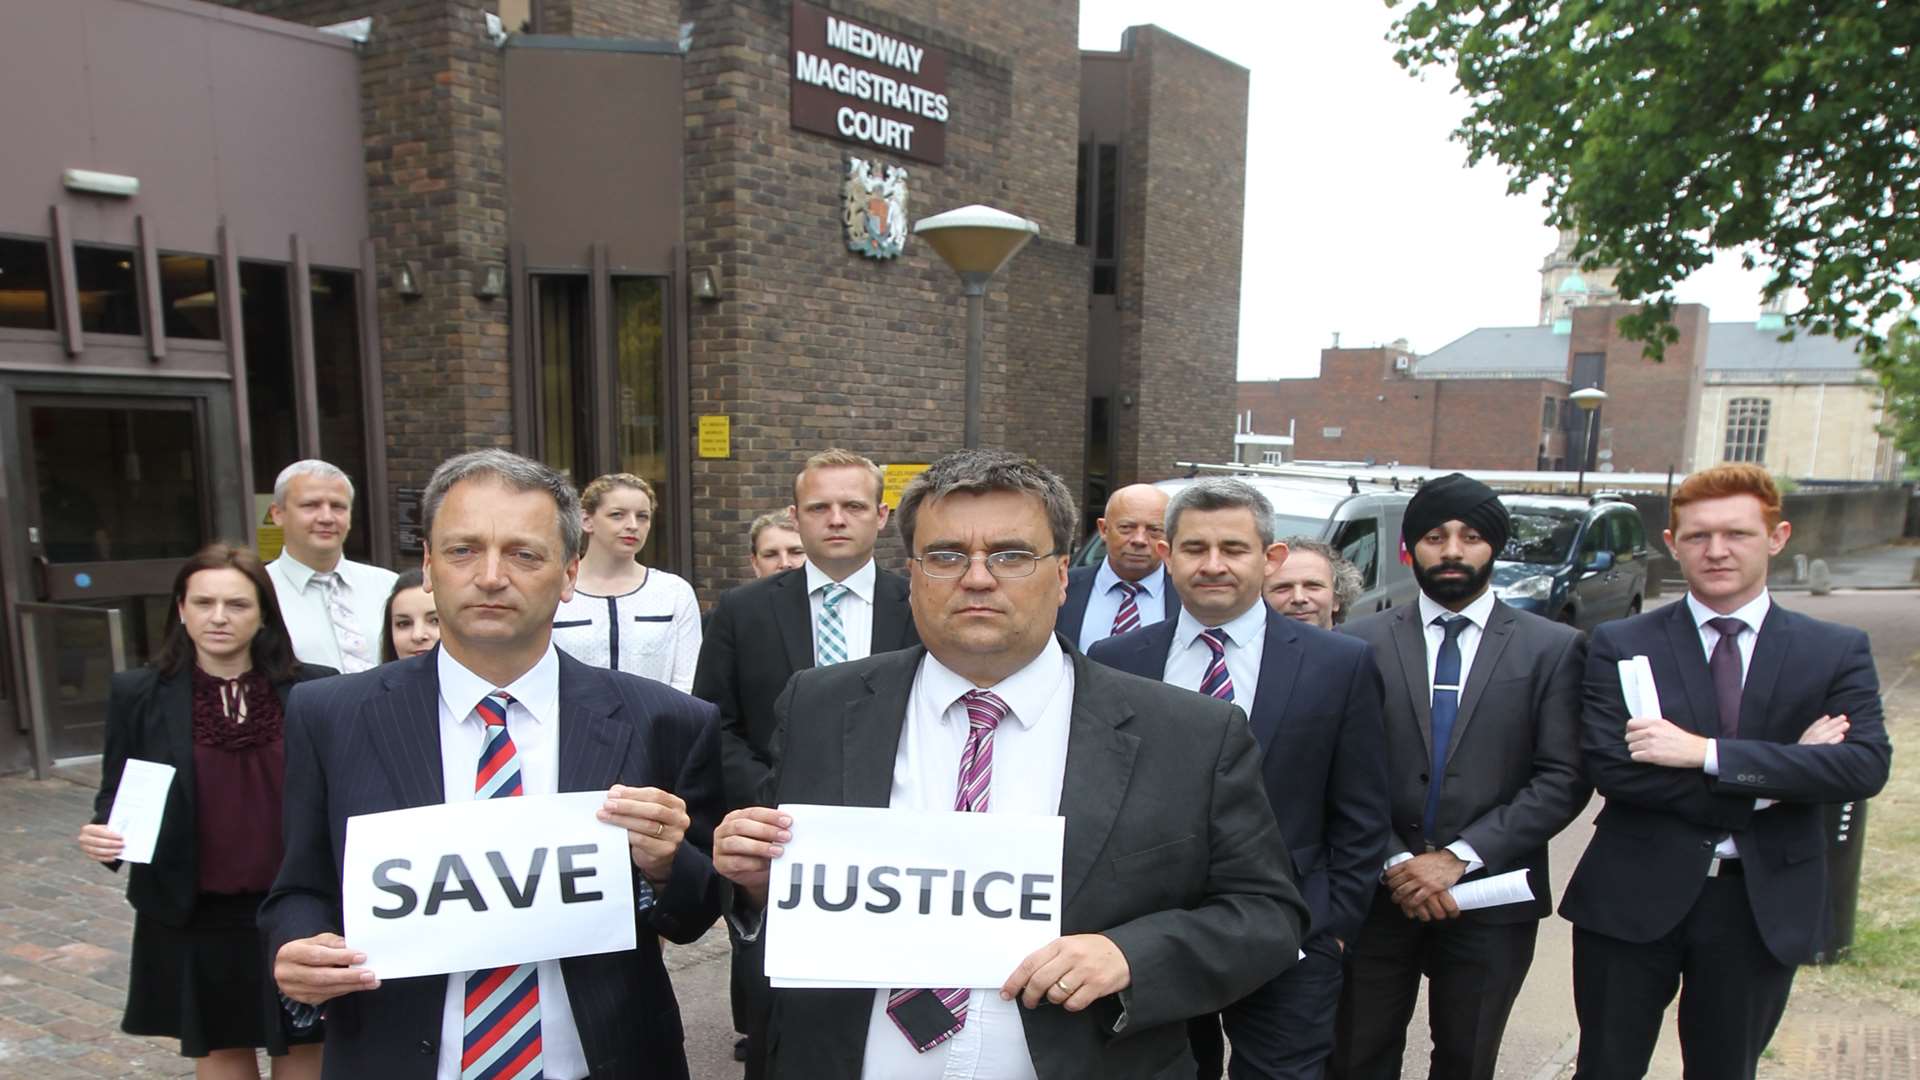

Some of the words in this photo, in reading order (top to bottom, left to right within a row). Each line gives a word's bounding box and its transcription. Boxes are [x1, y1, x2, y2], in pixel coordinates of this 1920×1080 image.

[827, 16, 924, 74] MEDWAY
[797, 51, 949, 122] MAGISTRATES
[837, 106, 914, 150] COURT
[372, 843, 603, 919] SAVE
[777, 862, 1054, 922] JUSTICE
